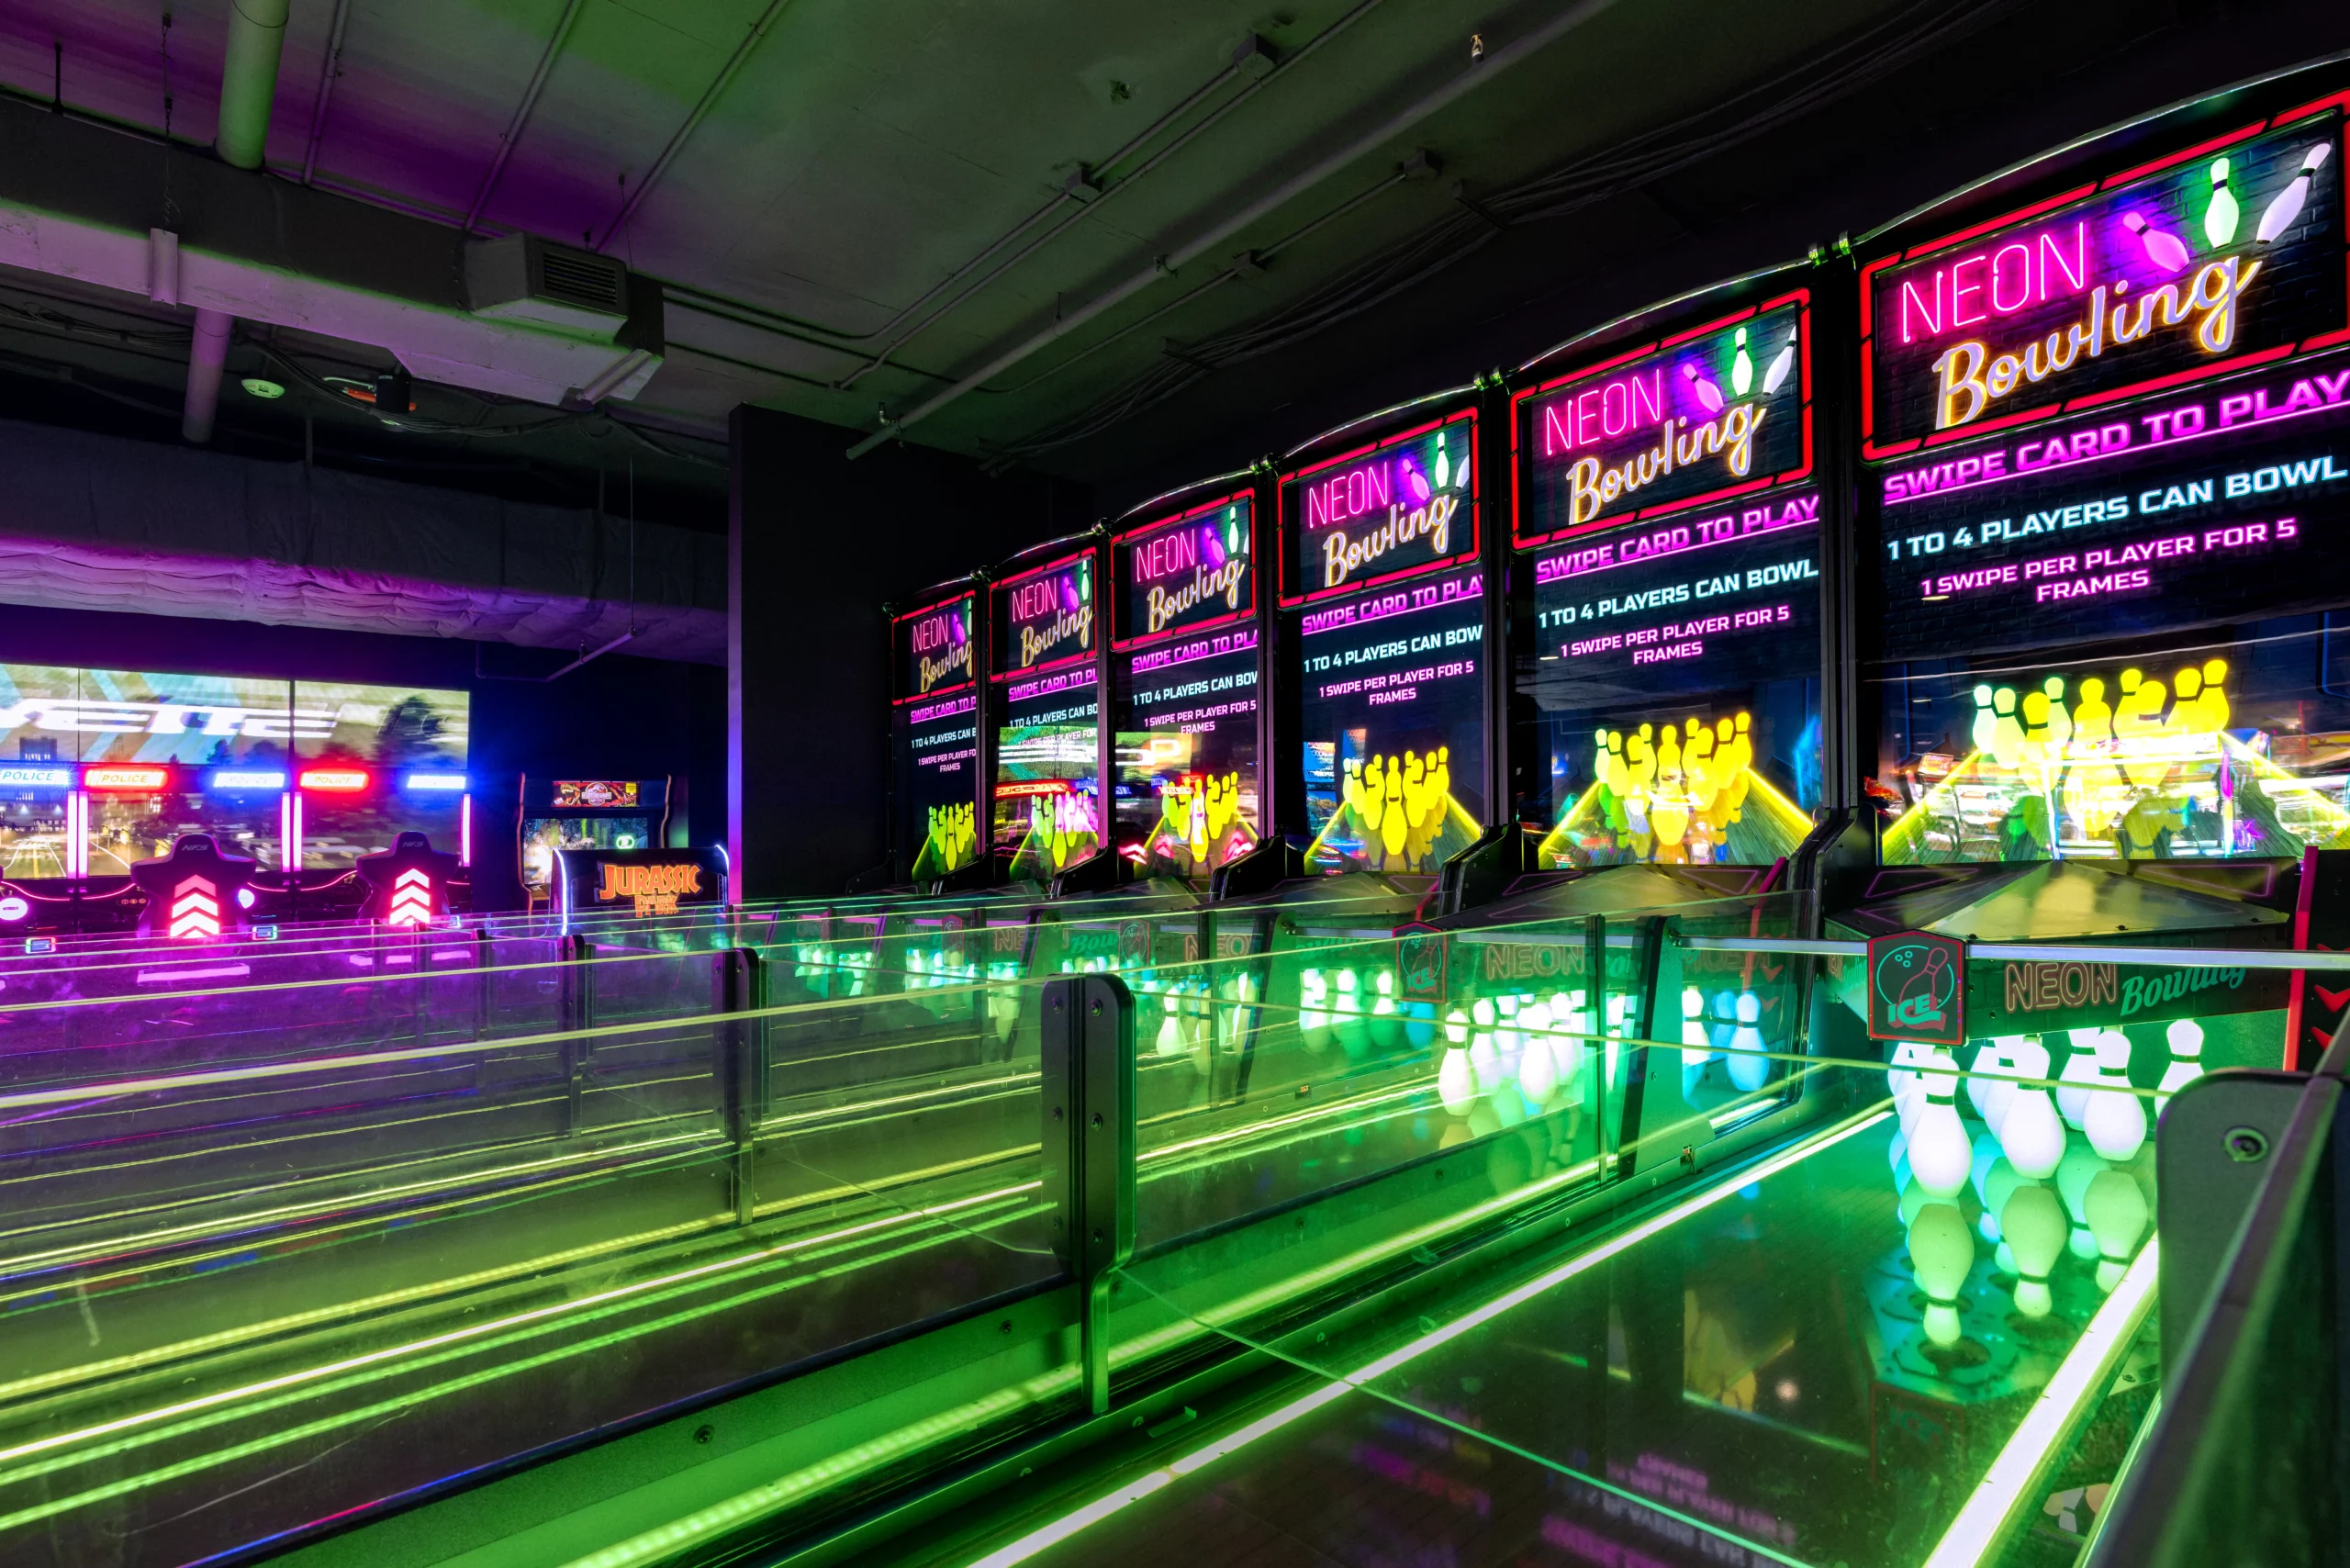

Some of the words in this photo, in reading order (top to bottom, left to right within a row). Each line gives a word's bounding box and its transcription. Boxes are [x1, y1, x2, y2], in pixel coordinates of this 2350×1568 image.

[1902, 222, 2086, 343] NEON
[1931, 255, 2262, 431] Bowling
[1545, 368, 1662, 456] NEON
[1884, 451, 2006, 499] SWIPE
[2016, 422, 2131, 472] CARD
[2143, 405, 2204, 442] TO
[2220, 370, 2350, 427] PLAY
[1565, 403, 1768, 526] Bowling
[1309, 462, 1389, 530] NEON
[1887, 540, 1900, 561] 1
[1908, 532, 1945, 556] TO
[1953, 526, 1974, 549] 4
[1981, 497, 2129, 543] PLAYERS
[2140, 476, 2213, 514] CAN
[2225, 455, 2348, 498] BOWL
[1136, 529, 1195, 583] NEON
[1323, 493, 1459, 588] Bowling
[1536, 543, 1614, 583] SWIPE
[1619, 526, 1689, 561] CARD
[1696, 516, 1734, 543] TO
[1742, 495, 1818, 534] PLAY
[1922, 577, 1932, 597] 1
[1937, 566, 2018, 594] SWIPE
[2025, 555, 2076, 580] PER
[2085, 534, 2196, 571] PLAYER
[2205, 524, 2266, 550] FOR
[2276, 518, 2297, 539] 5
[1013, 577, 1057, 622] NEON
[1147, 559, 1246, 633] Bowling
[1302, 605, 1356, 635] SWIPE
[1359, 593, 1408, 620] CARD
[1412, 586, 1438, 607] TO
[1442, 574, 1483, 601] PLA
[1539, 612, 1548, 628] 1
[1550, 606, 1577, 625] TO
[1580, 603, 1595, 621] 4
[1598, 584, 1690, 618] PLAYERS
[1695, 571, 1740, 599] CAN
[1747, 558, 1819, 589] BOWL
[2036, 569, 2150, 602] FRAMES
[912, 613, 948, 654] NEON
[1021, 605, 1092, 667] Bowling
[1561, 642, 1568, 657] 1
[1571, 634, 1621, 656] SWIPE
[1625, 629, 1658, 648] PER
[1662, 614, 1729, 644] PLAYER
[1734, 607, 1774, 628] FOR
[1777, 605, 1790, 622] 5
[920, 640, 973, 693] Bowling
[1132, 649, 1171, 671] SWIPE
[1174, 641, 1209, 660] CARD
[1212, 635, 1230, 653] TO
[1304, 660, 1310, 673] 1
[1311, 655, 1329, 671] TO
[1331, 652, 1342, 667] 4
[1345, 639, 1408, 665] PLAYERS
[1411, 632, 1441, 653] CAN
[1633, 642, 1703, 666] FRAMES
[1009, 680, 1038, 700] SWIPE
[1041, 675, 1067, 692] CARD
[1069, 670, 1083, 685] TO
[1139, 691, 1153, 704] TO
[1155, 689, 1161, 702] 4
[1163, 680, 1209, 700] PLAYERS
[1211, 675, 1234, 691] CAN
[1326, 679, 1362, 697] SWIPE
[1364, 675, 1387, 690] PER
[1389, 666, 1435, 689] PLAYER
[1438, 662, 1463, 678] FOR
[1465, 660, 1474, 674] 5
[1368, 687, 1416, 706] FRAMES
[911, 706, 934, 722] SWIPE
[935, 700, 957, 716] CARD
[958, 697, 969, 711] TO
[1013, 718, 1024, 729] TO
[1032, 709, 1067, 726] PLAYERS
[1069, 705, 1085, 720] CAN
[1149, 712, 1175, 726] SWIPE
[1177, 710, 1193, 722] PER
[1195, 704, 1228, 721] PLAYER
[1230, 701, 1248, 714] FOR
[1249, 700, 1257, 711] 5
[1181, 722, 1215, 734] FRAMES
[915, 737, 923, 748] TO
[929, 730, 957, 745] PLAYERS
[957, 728, 970, 740] CAN
[921, 756, 936, 766] SWIPE
[937, 754, 947, 763] PER
[948, 750, 968, 761] PLAYER
[2, 771, 55, 781] POLICE
[101, 775, 149, 783] POLICE
[939, 762, 961, 773] FRAMES
[599, 864, 701, 900] JURASSIC
[1407, 967, 1436, 991] ICE
[1483, 943, 1586, 980] NEON
[2004, 961, 2119, 1013] NEON
[1887, 992, 1942, 1026] ICE
